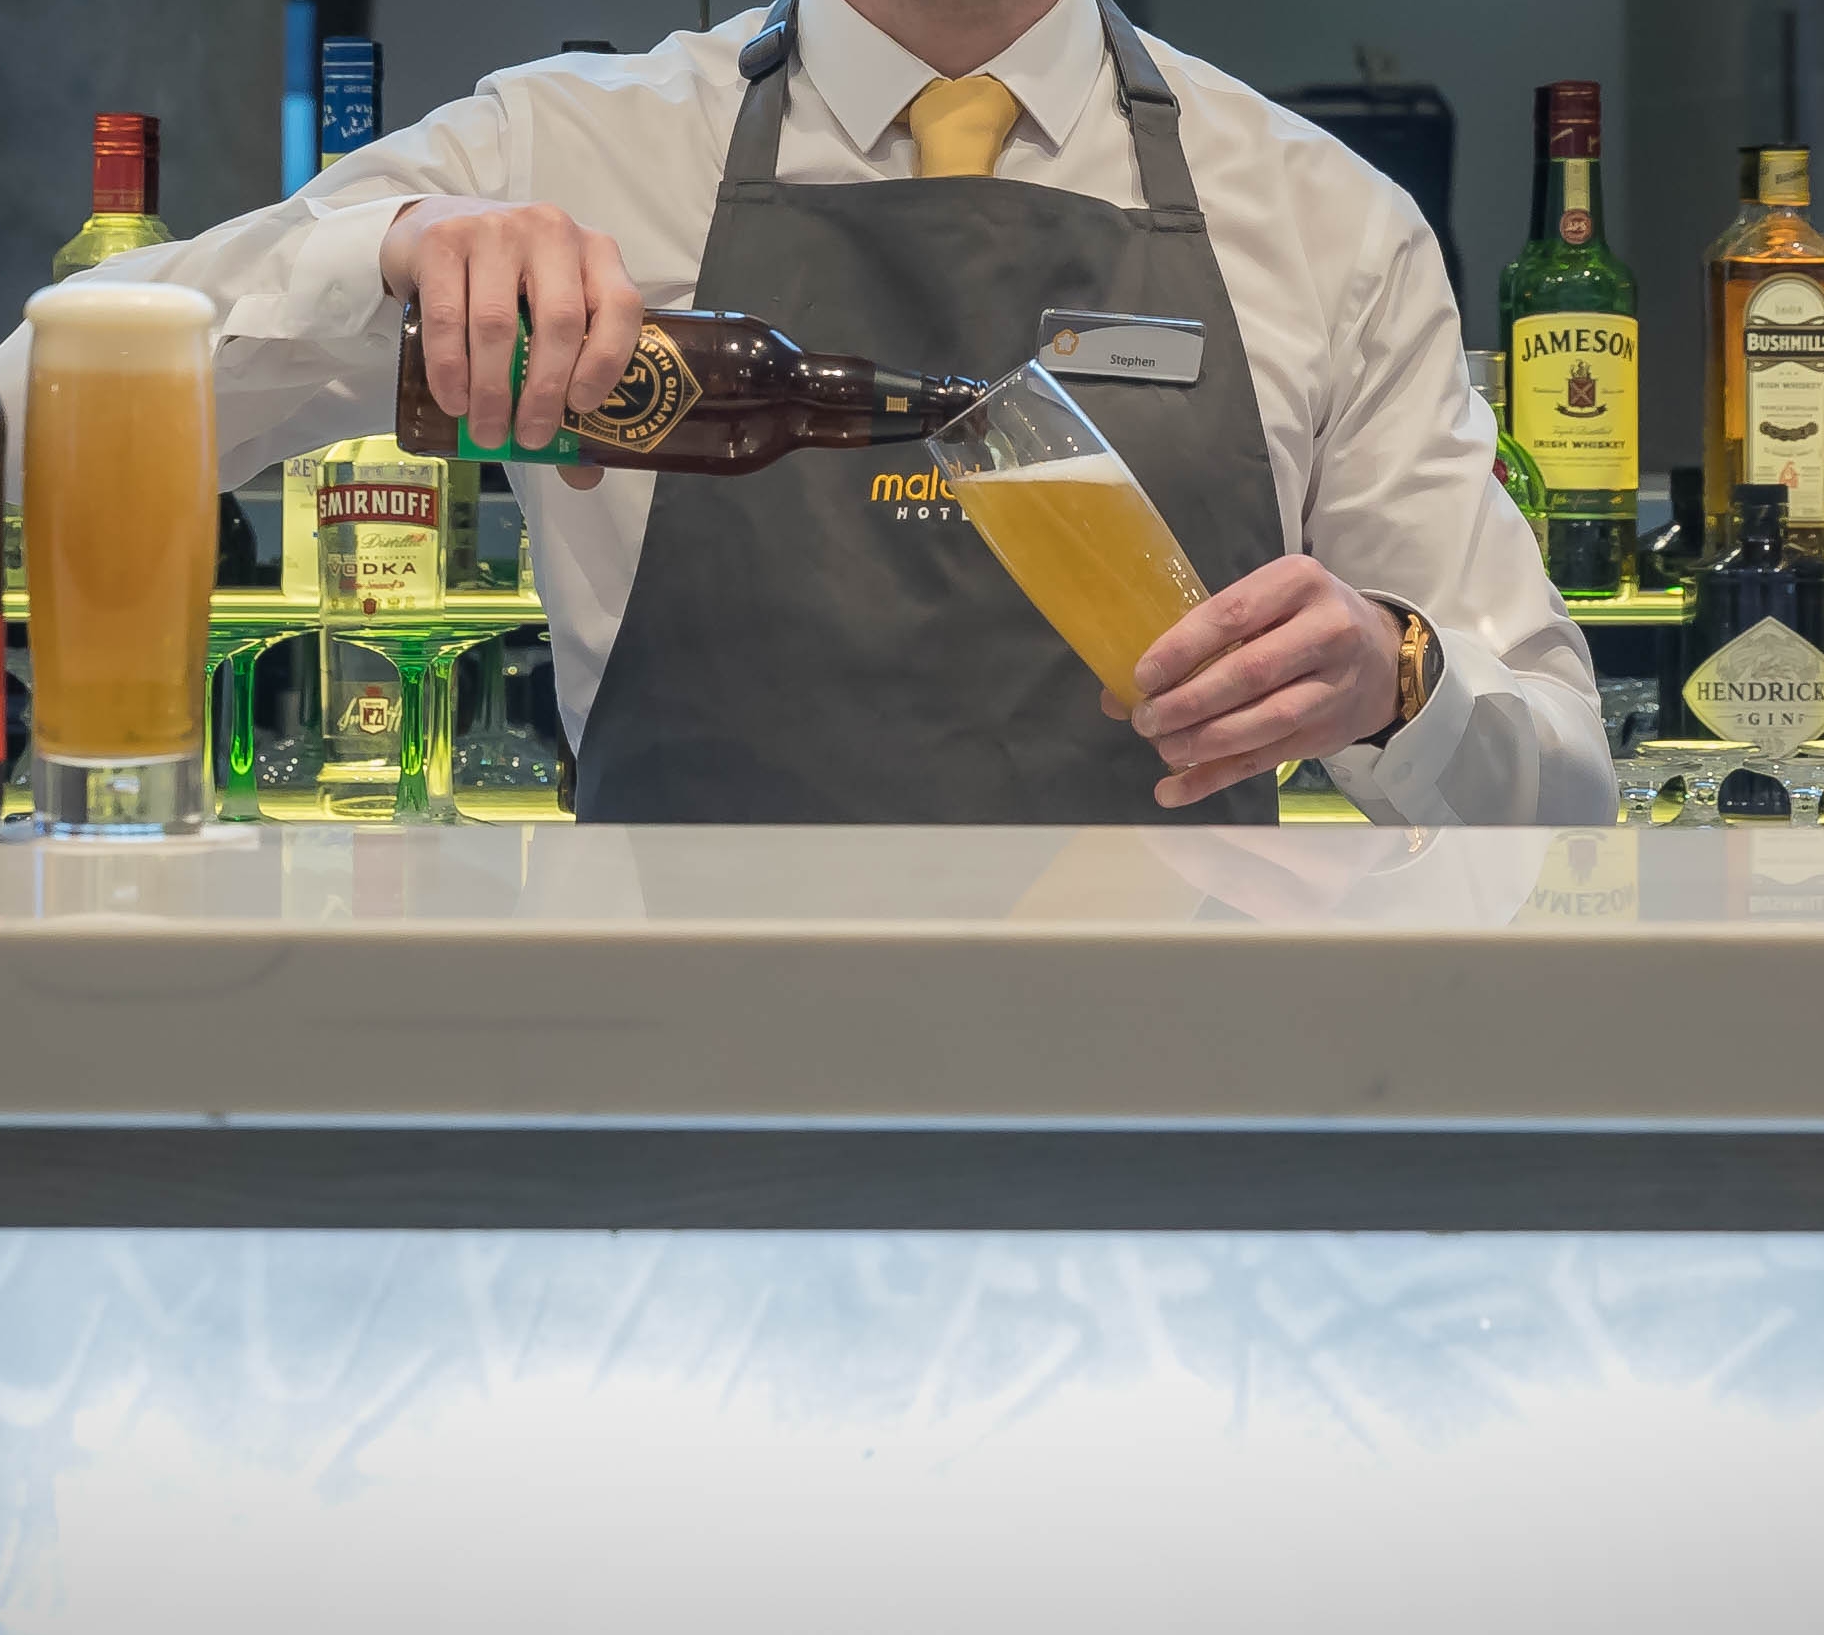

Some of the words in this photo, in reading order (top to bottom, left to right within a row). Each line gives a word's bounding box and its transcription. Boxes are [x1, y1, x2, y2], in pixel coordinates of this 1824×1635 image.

[639, 338, 674, 371] IFTH
[1522, 329, 1635, 362] JAMESON
[1109, 353, 1157, 368] Stephen
[626, 377, 677, 439] QUARTER
[1533, 440, 1567, 448] IRISH
[1571, 440, 1625, 449] WHISKEY
[319, 490, 430, 518] SMIRNOFF
[327, 562, 417, 577] VODKA
[1748, 713, 1794, 726] GIN
